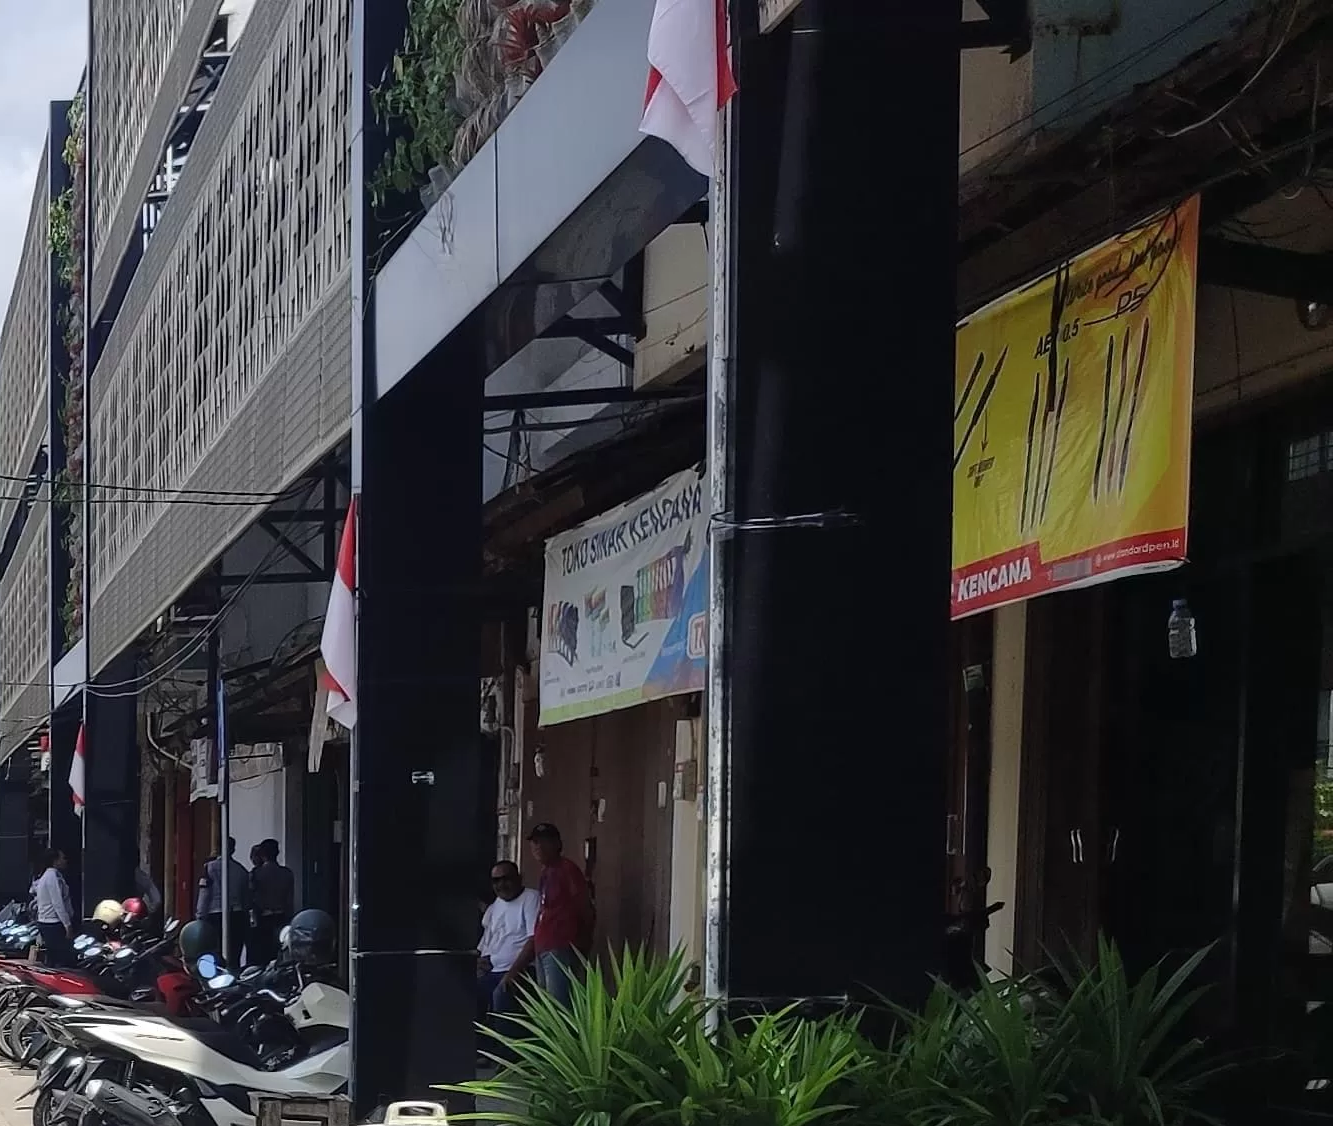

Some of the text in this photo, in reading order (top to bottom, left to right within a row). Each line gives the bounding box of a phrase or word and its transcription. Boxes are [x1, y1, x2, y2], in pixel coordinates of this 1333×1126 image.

[562, 483, 703, 577] TOKO SINAR KENCANA
[957, 556, 1032, 602] KENCANA
